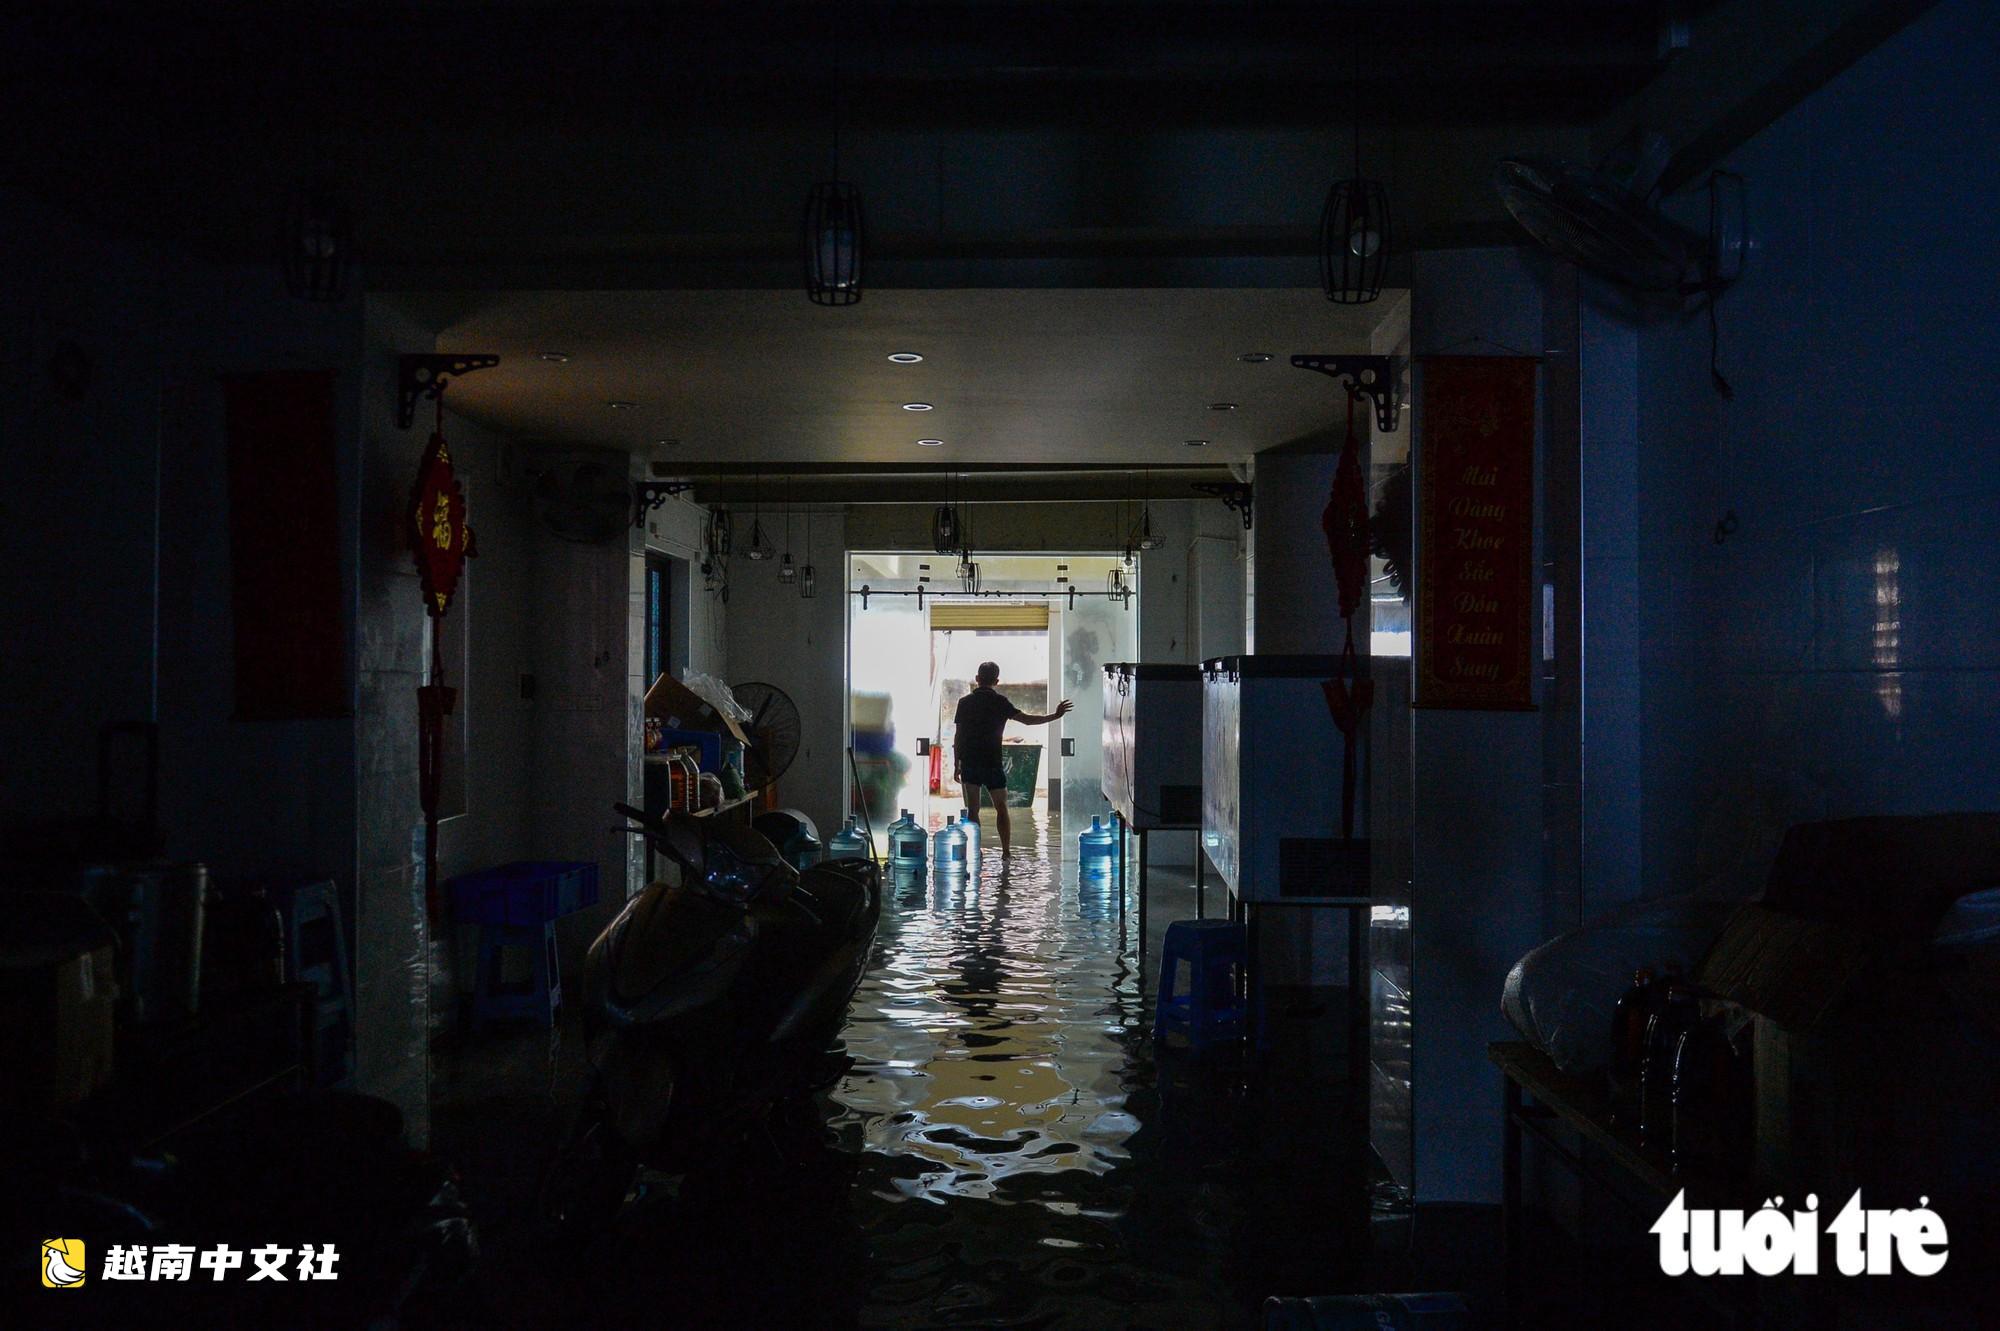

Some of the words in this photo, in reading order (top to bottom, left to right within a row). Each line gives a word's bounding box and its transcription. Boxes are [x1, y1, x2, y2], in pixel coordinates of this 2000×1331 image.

[1456, 464, 1499, 487] Mai
[1448, 528, 1505, 551] Khoe
[1449, 655, 1501, 681] Sang
